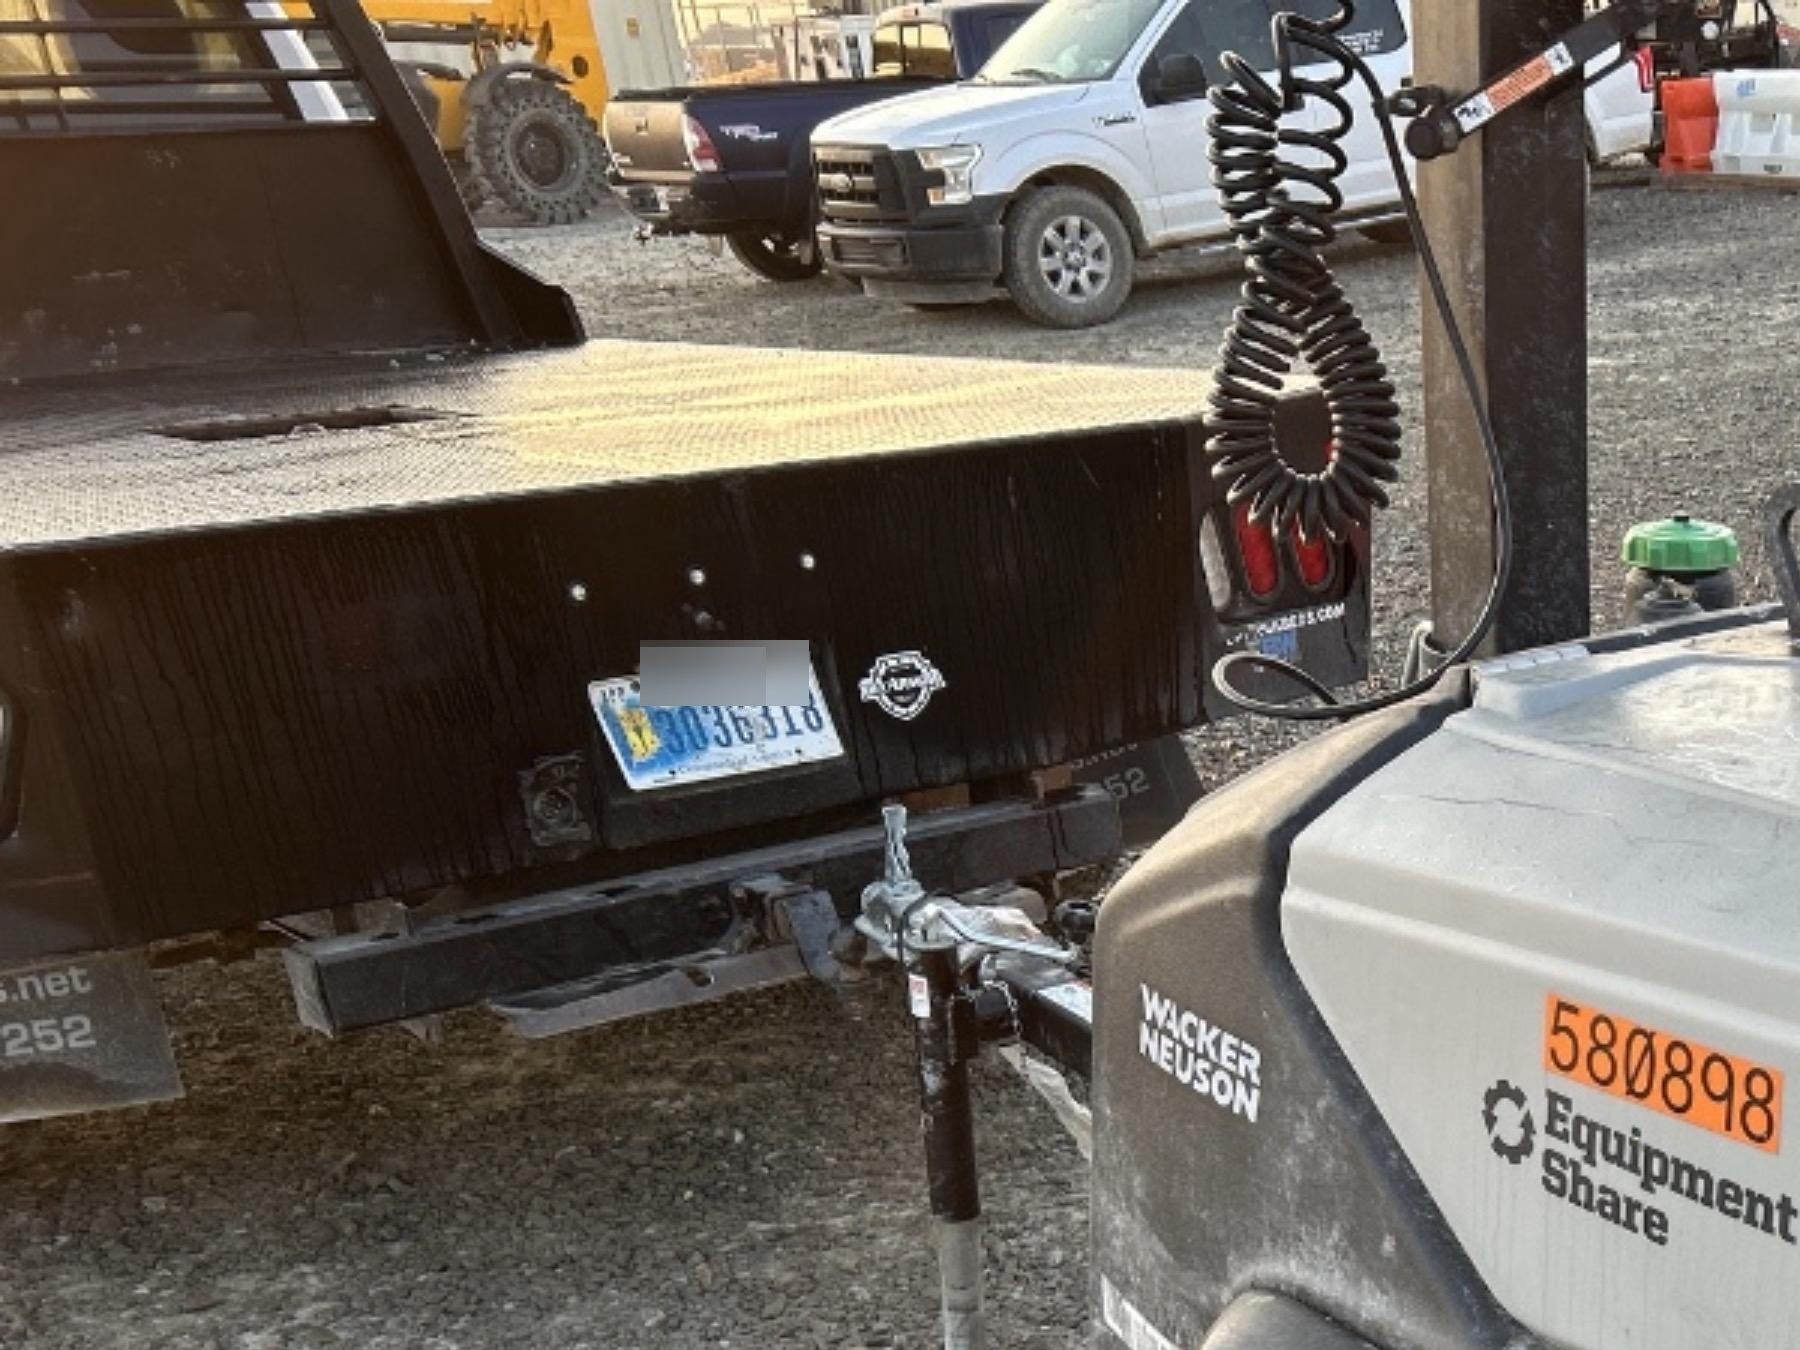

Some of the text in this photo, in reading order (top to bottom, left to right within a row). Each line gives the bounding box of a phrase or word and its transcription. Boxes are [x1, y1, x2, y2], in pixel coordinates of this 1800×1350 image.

[1139, 1021, 1261, 1123] NEUSON
[1140, 982, 1261, 1087] WACKER
[1549, 999, 1776, 1144] 580898
[1541, 1149, 1669, 1246] Share
[1545, 1088, 1798, 1245] Equipment
